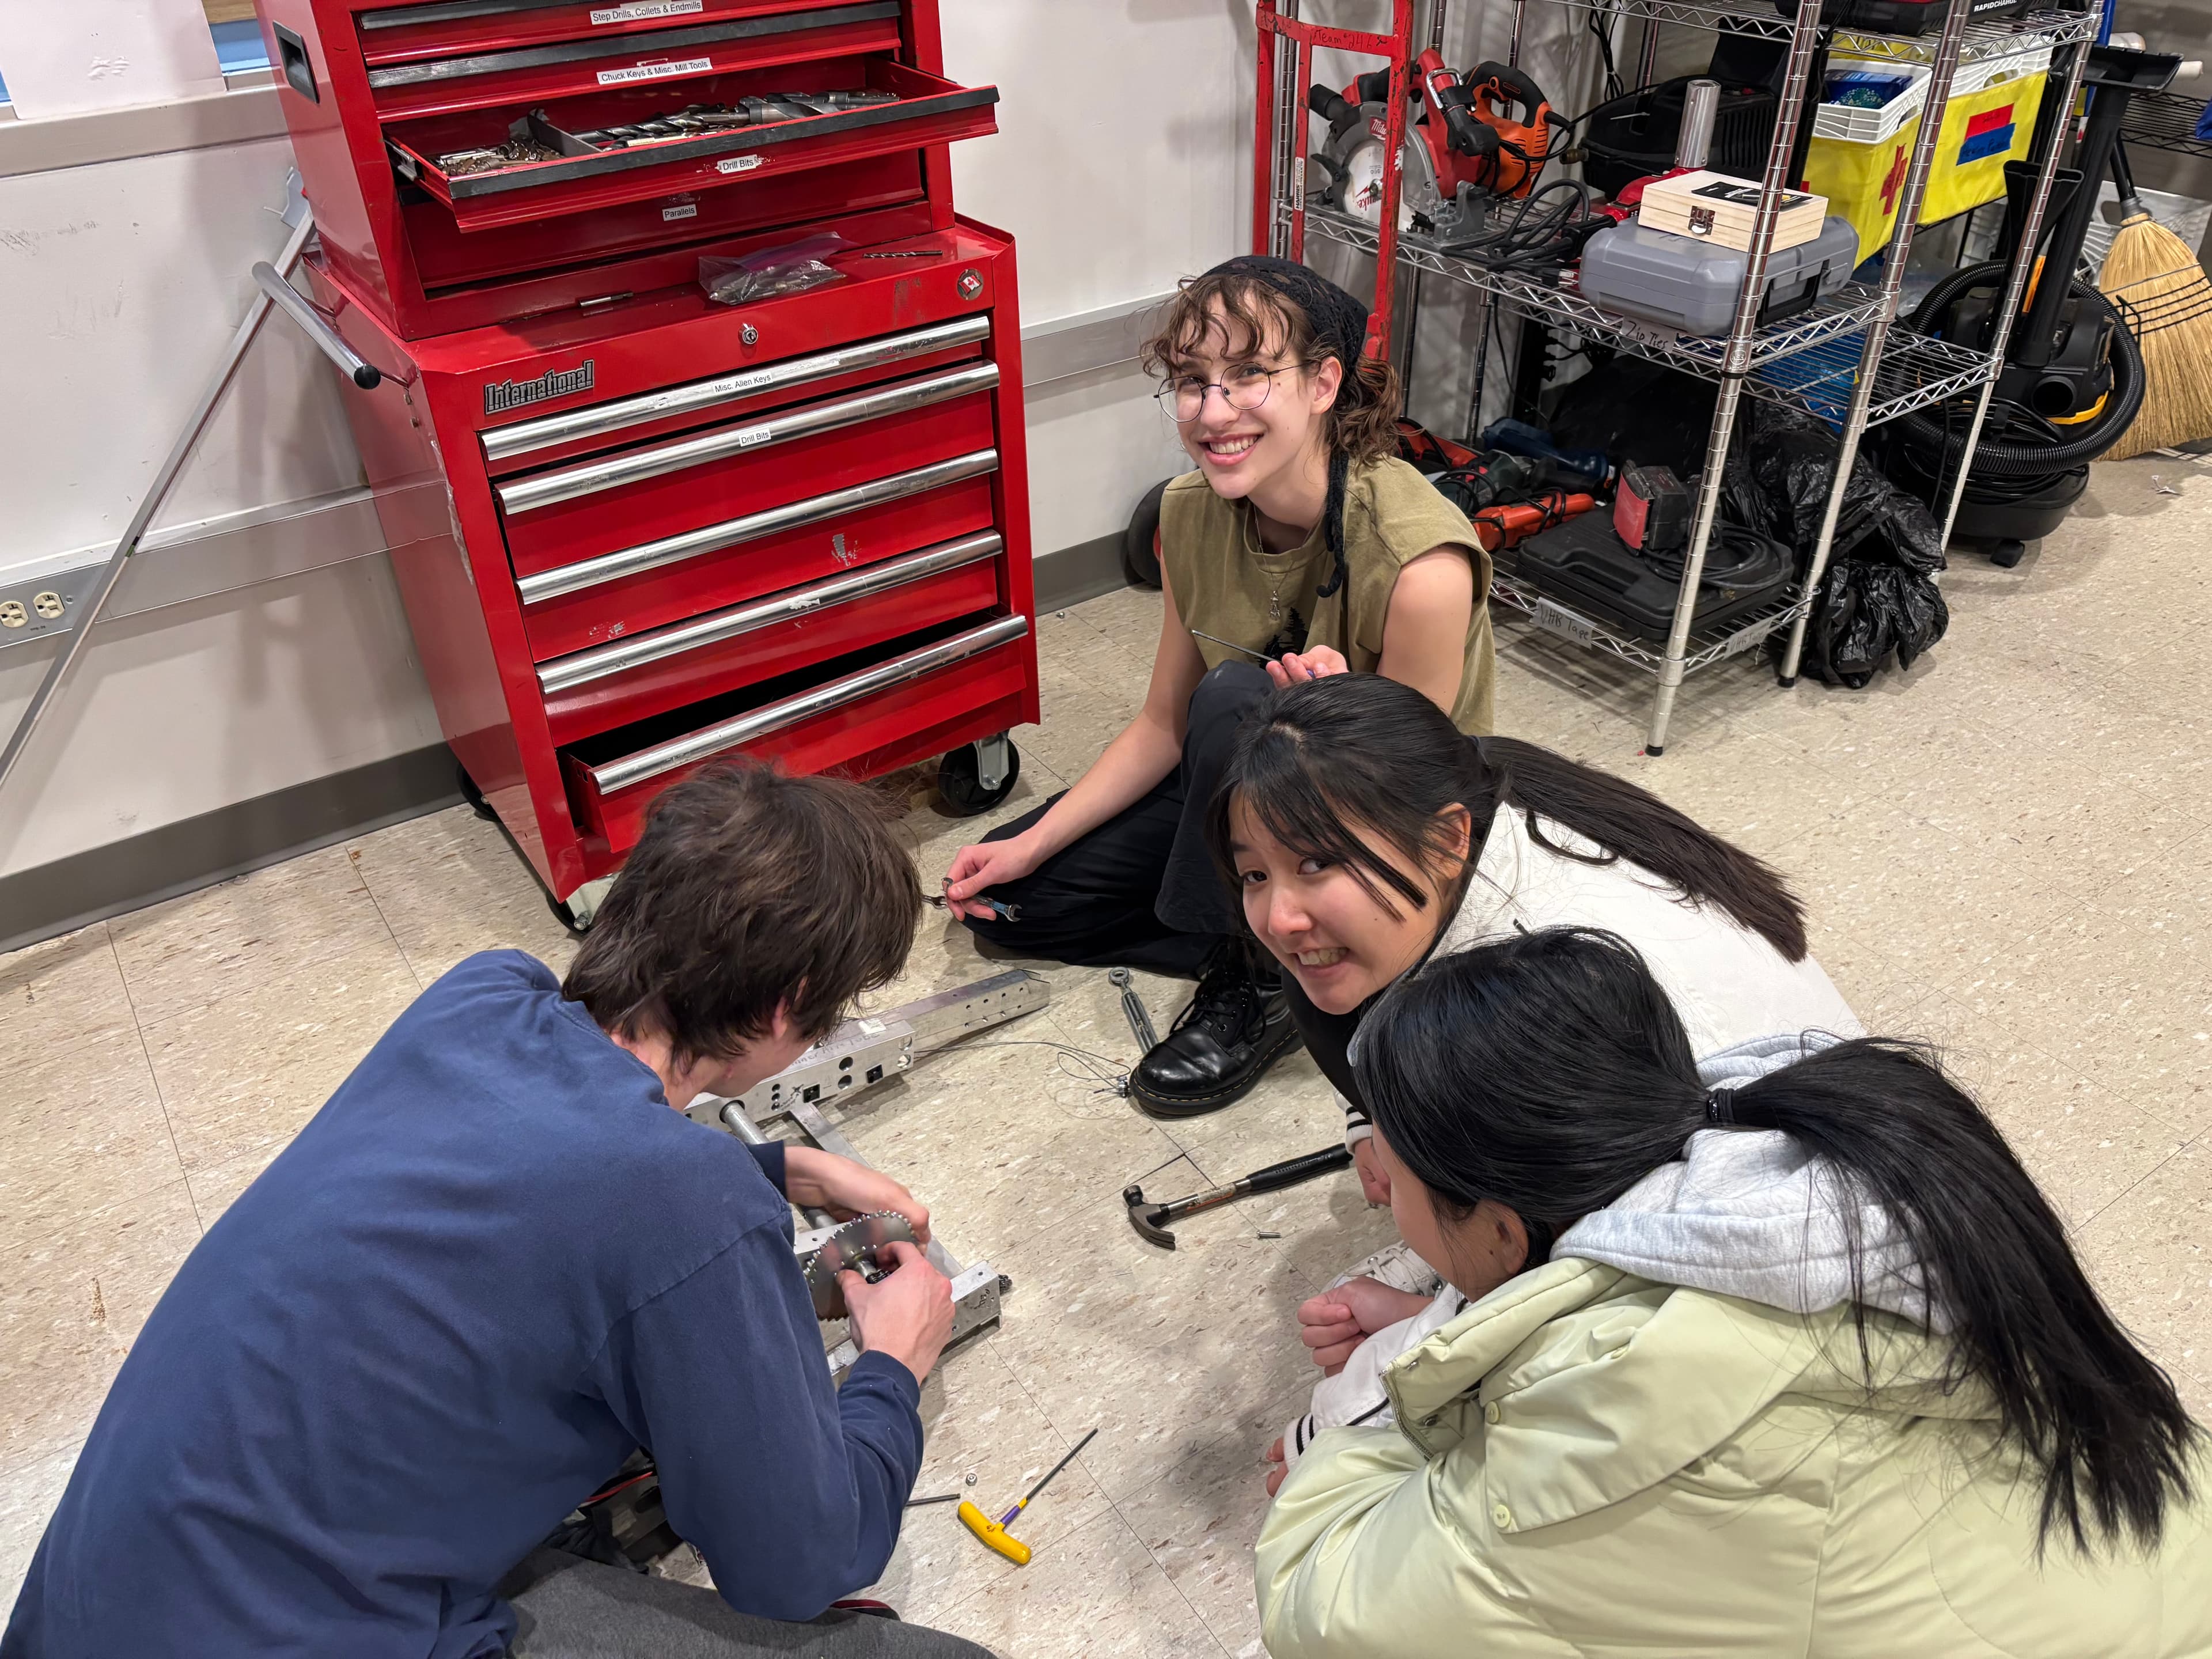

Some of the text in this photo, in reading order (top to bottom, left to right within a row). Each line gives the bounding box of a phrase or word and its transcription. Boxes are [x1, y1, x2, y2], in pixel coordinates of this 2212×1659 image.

[593, 2, 701, 22] Step Drills, Collets & Endmills
[601, 71, 625, 82] Chuck
[627, 69, 646, 79] Keys
[654, 66, 673, 75] Misc.
[675, 63, 687, 72] Mill
[689, 60, 708, 70] Tools
[723, 158, 754, 171] Drill Bits
[664, 207, 695, 218] Parallels
[1626, 320, 1645, 340] Zip
[486, 360, 594, 414] International
[715, 374, 771, 392] Misc. Allen Keys
[741, 432, 769, 444] Drill Bits
[1565, 616, 1589, 641] Tape
